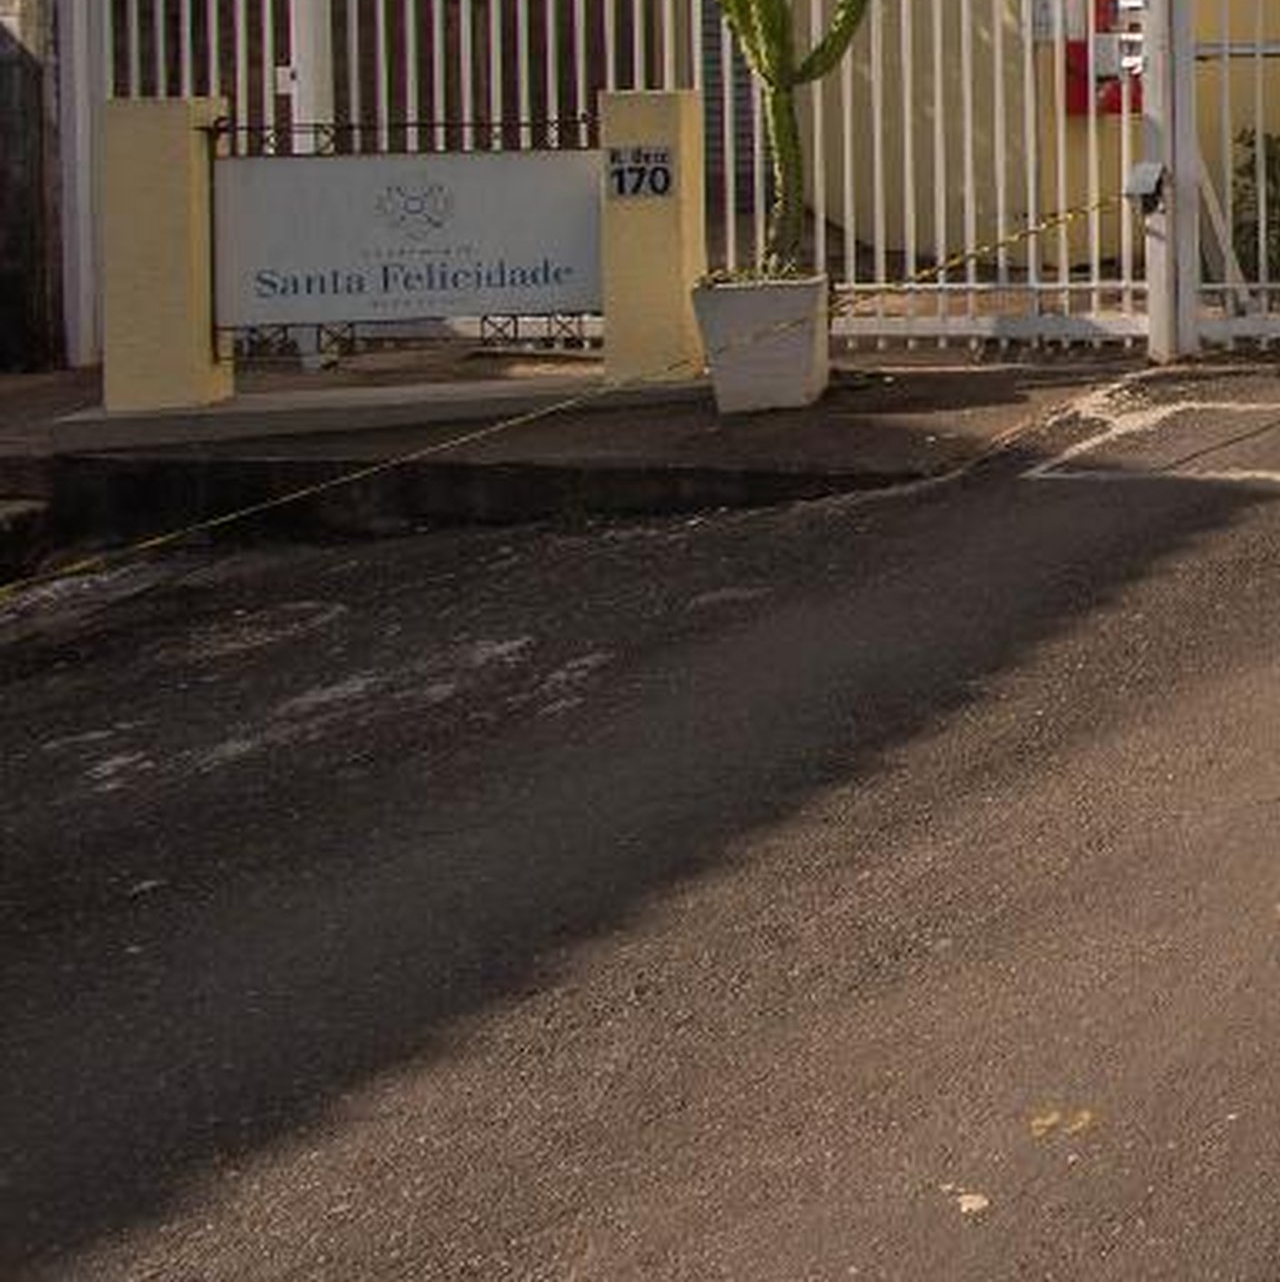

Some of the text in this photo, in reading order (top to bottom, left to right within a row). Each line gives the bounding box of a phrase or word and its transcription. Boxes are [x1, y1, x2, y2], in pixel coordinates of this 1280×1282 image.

[610, 166, 671, 196] 170
[255, 258, 574, 299] Santa Felicidade
